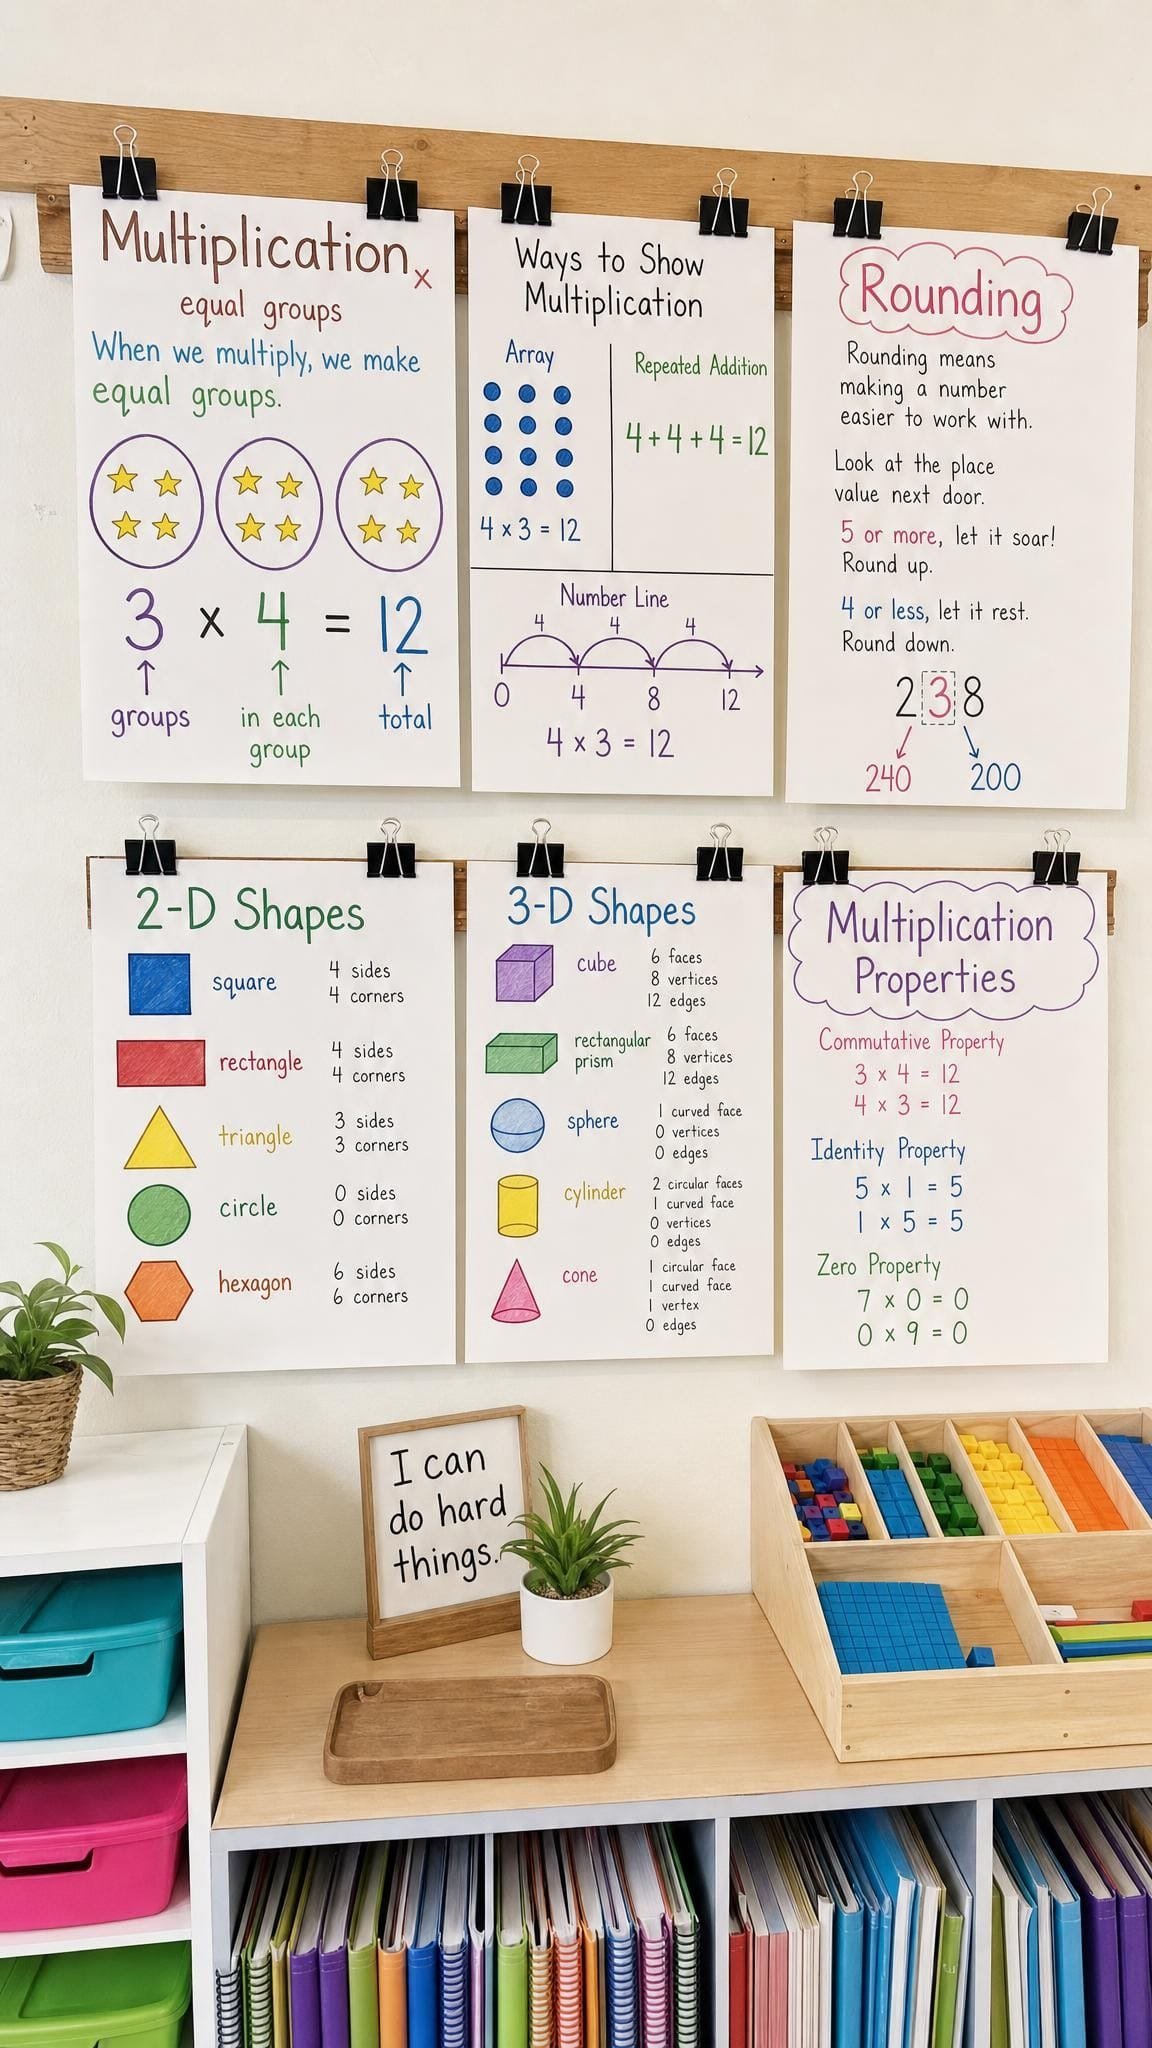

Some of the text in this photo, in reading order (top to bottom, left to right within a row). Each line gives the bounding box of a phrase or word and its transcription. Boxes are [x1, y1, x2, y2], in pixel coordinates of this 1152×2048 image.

[102, 209, 408, 284] Multiplication
[515, 237, 704, 282] Ways to Show
[181, 289, 342, 332] equal groups
[526, 281, 702, 327] Multiplication
[860, 261, 1044, 336] Rounding
[92, 331, 420, 377] When we multiply, we make
[506, 339, 554, 373] Array
[848, 340, 995, 375] Rounding means
[635, 351, 767, 382] Repeated Addition
[93, 374, 281, 418] equal groups.
[841, 374, 1007, 405] making a number
[841, 406, 1032, 429] easier to work with.
[835, 449, 995, 482] Look at the place
[835, 482, 984, 505] value next door.
[842, 520, 1055, 548] 5 or more, let it soar!
[843, 551, 932, 581] Round up.
[561, 583, 669, 608] Number Line
[125, 588, 163, 651] 3
[257, 592, 290, 651] 4
[325, 615, 350, 633] =
[381, 596, 428, 654] 12
[841, 596, 1028, 624] 4 or less, let it rest.
[843, 630, 954, 653] Round down.
[111, 709, 190, 738] groups
[242, 704, 320, 728] in each
[378, 703, 431, 730] total
[250, 744, 310, 768] group
[866, 764, 911, 792] 240
[971, 763, 1021, 791] 200
[137, 887, 364, 944] 2-D Shapes
[508, 886, 696, 937] 3-D Shapes
[828, 900, 1052, 957] Multiplication
[577, 952, 616, 972] cube
[652, 948, 702, 964] 6 faces
[330, 960, 390, 979] 4 sides
[651, 970, 718, 986] 8 vertices
[857, 956, 1015, 1007] Properties
[213, 976, 277, 1000] square
[330, 986, 404, 1003] 4 corners
[648, 992, 706, 1012] 12 edges
[575, 1030, 651, 1054] rectangular
[668, 1026, 718, 1042] 6 faces
[820, 1027, 1004, 1056] Commutative Property
[332, 1041, 393, 1059] 4 sides
[667, 1048, 733, 1064] 8 vertices
[220, 1050, 303, 1079] rectangle
[333, 1066, 405, 1083] 4 corners
[576, 1054, 613, 1075] prism
[664, 1070, 719, 1090] 12 edges
[335, 1112, 394, 1129] 3 sides
[672, 1103, 709, 1117] curved
[717, 1102, 742, 1117] face
[568, 1109, 619, 1136] sphere
[656, 1124, 719, 1139] 0 vertices
[219, 1123, 292, 1153] triangle
[336, 1136, 408, 1153] 3 corners
[655, 1145, 708, 1164] 0 edges
[811, 1136, 965, 1167] Identity Property
[335, 1184, 396, 1201] 0 sides
[564, 1181, 626, 1208] cylinder
[653, 1175, 742, 1190] 2 circular faces
[220, 1194, 277, 1217] circle
[667, 1196, 703, 1209] curved
[710, 1195, 734, 1208] face
[333, 1209, 408, 1226] 0 corners
[650, 1216, 711, 1229] 0 vertices
[651, 1234, 700, 1252] 0 edges
[334, 1261, 395, 1280] 6 sides
[563, 1270, 598, 1283] cone
[663, 1259, 704, 1272] circular
[712, 1258, 736, 1271] face
[817, 1252, 940, 1282] Zero Property
[219, 1269, 291, 1300] hexagon
[334, 1288, 408, 1304] 6 corners
[662, 1278, 699, 1292] curved
[707, 1277, 732, 1291] face
[662, 1298, 699, 1311] vertex
[390, 1449, 485, 1487] I can
[390, 1483, 506, 1535] do hard
[393, 1544, 498, 1583] things.
